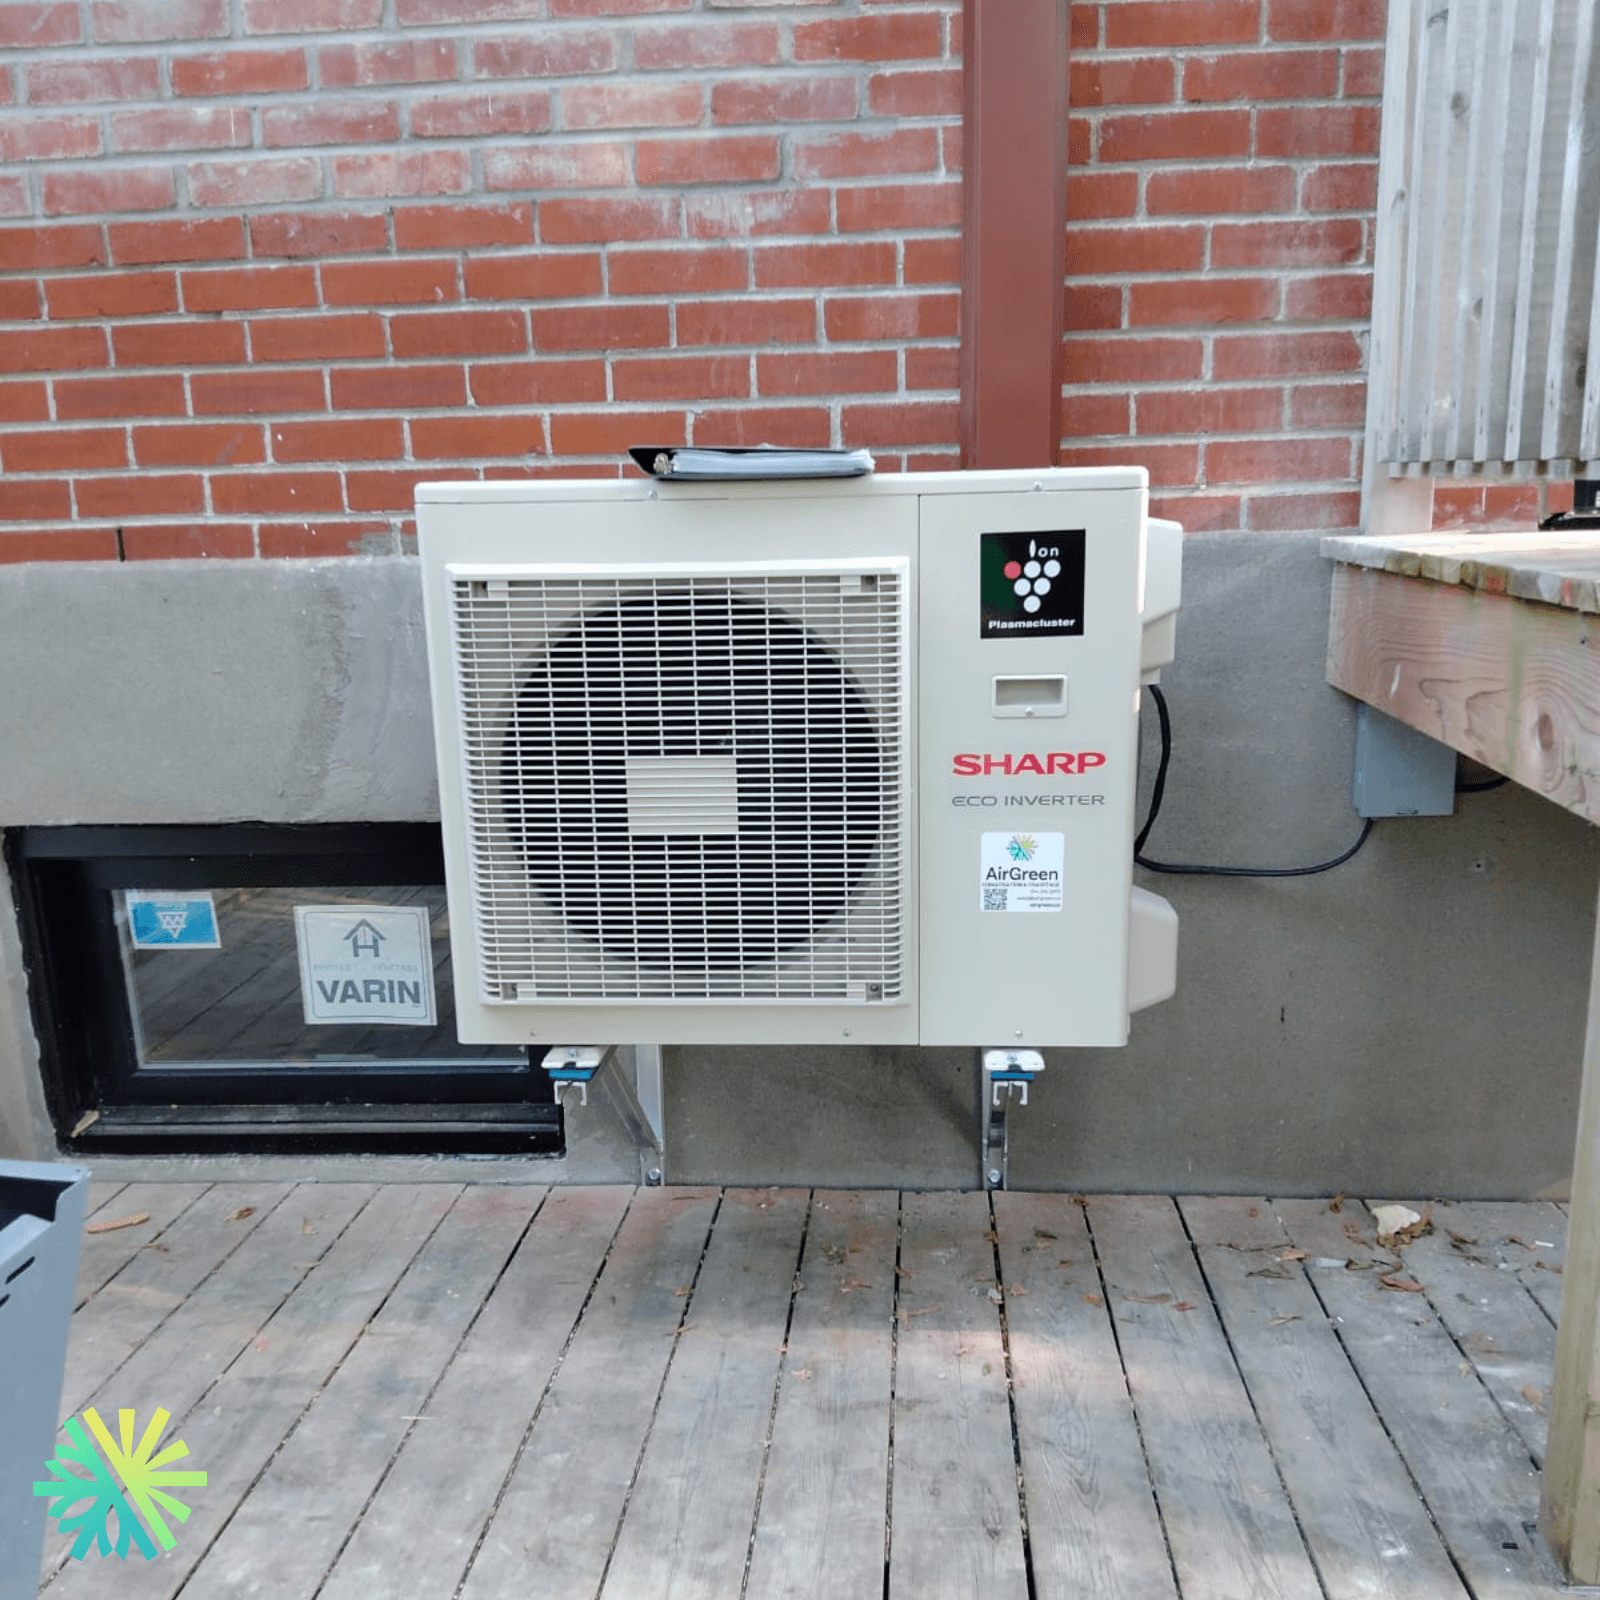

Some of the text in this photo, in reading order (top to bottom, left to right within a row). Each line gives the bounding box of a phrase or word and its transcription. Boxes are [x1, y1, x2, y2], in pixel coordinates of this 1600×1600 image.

[988, 618, 1076, 629] Plasmacluster
[952, 751, 1107, 776] SHARP
[951, 795, 1105, 807] ECO INVERTER
[986, 866, 1059, 881] AirGreen
[316, 979, 421, 1004] VARIN
